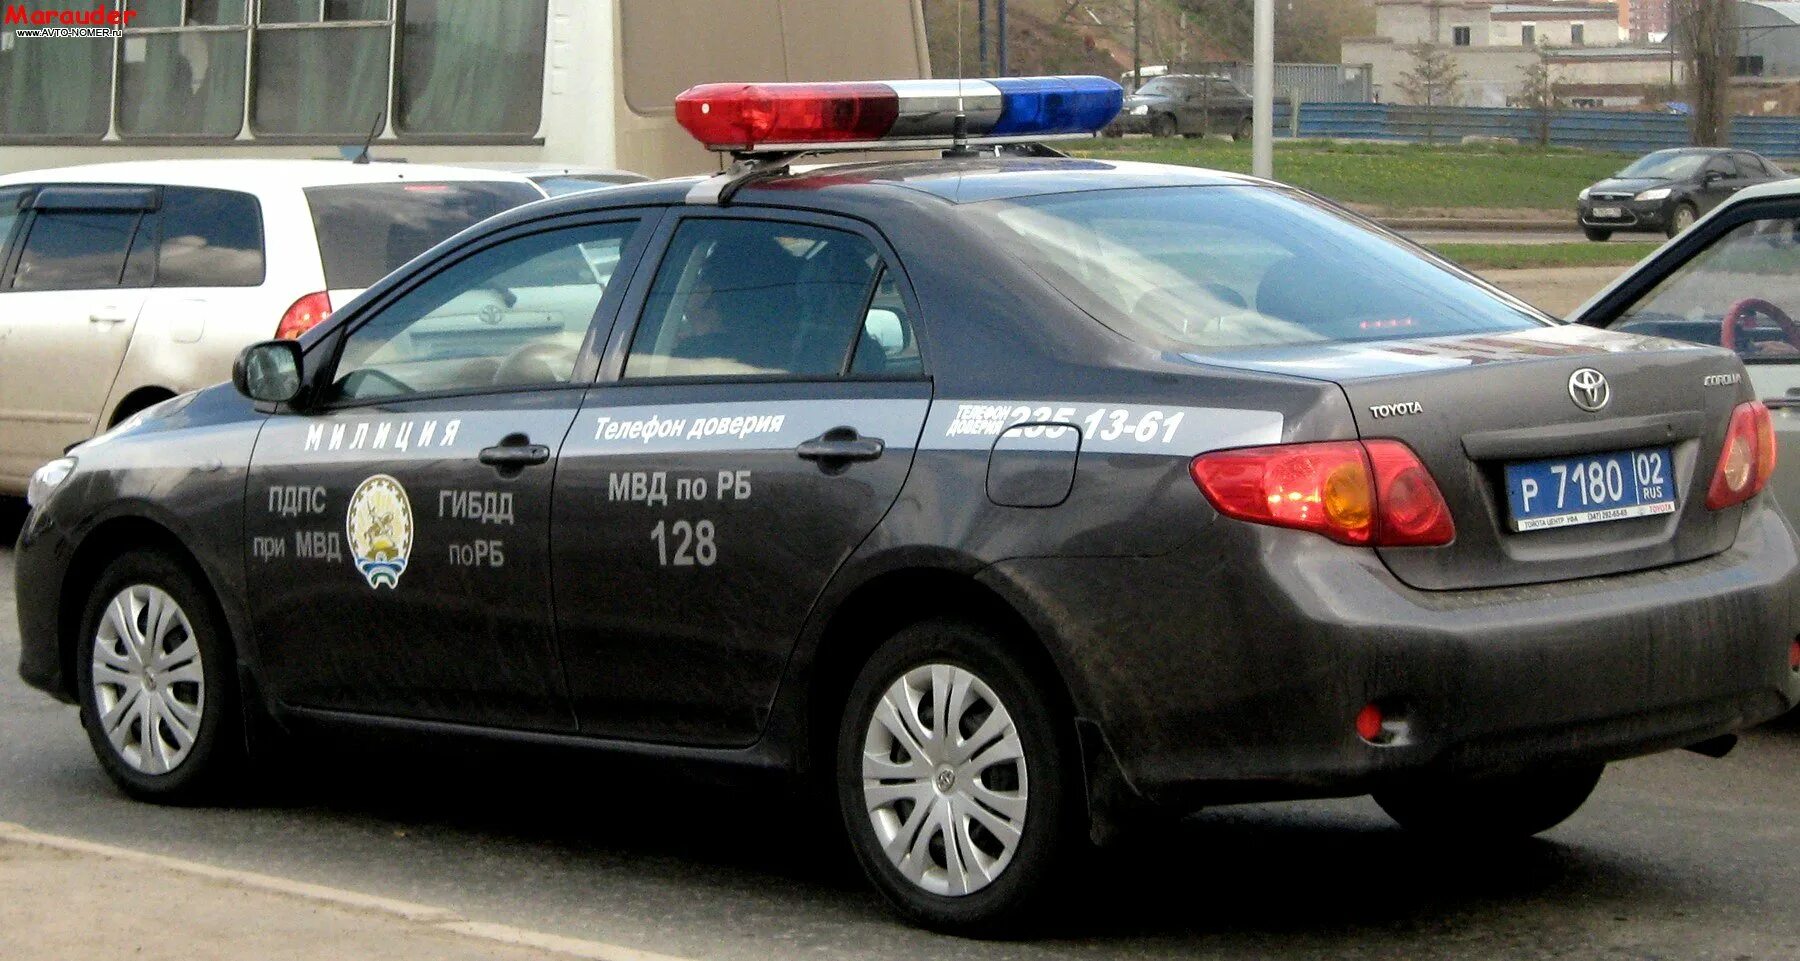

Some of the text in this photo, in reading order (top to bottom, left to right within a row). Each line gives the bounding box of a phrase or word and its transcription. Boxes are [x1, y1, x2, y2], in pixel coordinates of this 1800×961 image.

[1004, 405, 1185, 443] 235-13-61
[1369, 401, 1424, 419] TOYOTA
[304, 419, 462, 452] МИЛИЦИЯ
[594, 414, 786, 444] Телефон доверия
[1551, 459, 1623, 509] 7180
[1637, 452, 1664, 486] 02
[268, 486, 327, 518] ПДПС
[608, 470, 752, 507] МВД по РБ
[1643, 486, 1663, 500] RUS
[438, 490, 515, 526] ГИБДД
[1649, 505, 1672, 514] TOYOTA
[253, 531, 343, 563] при МВД
[650, 519, 718, 567] 128
